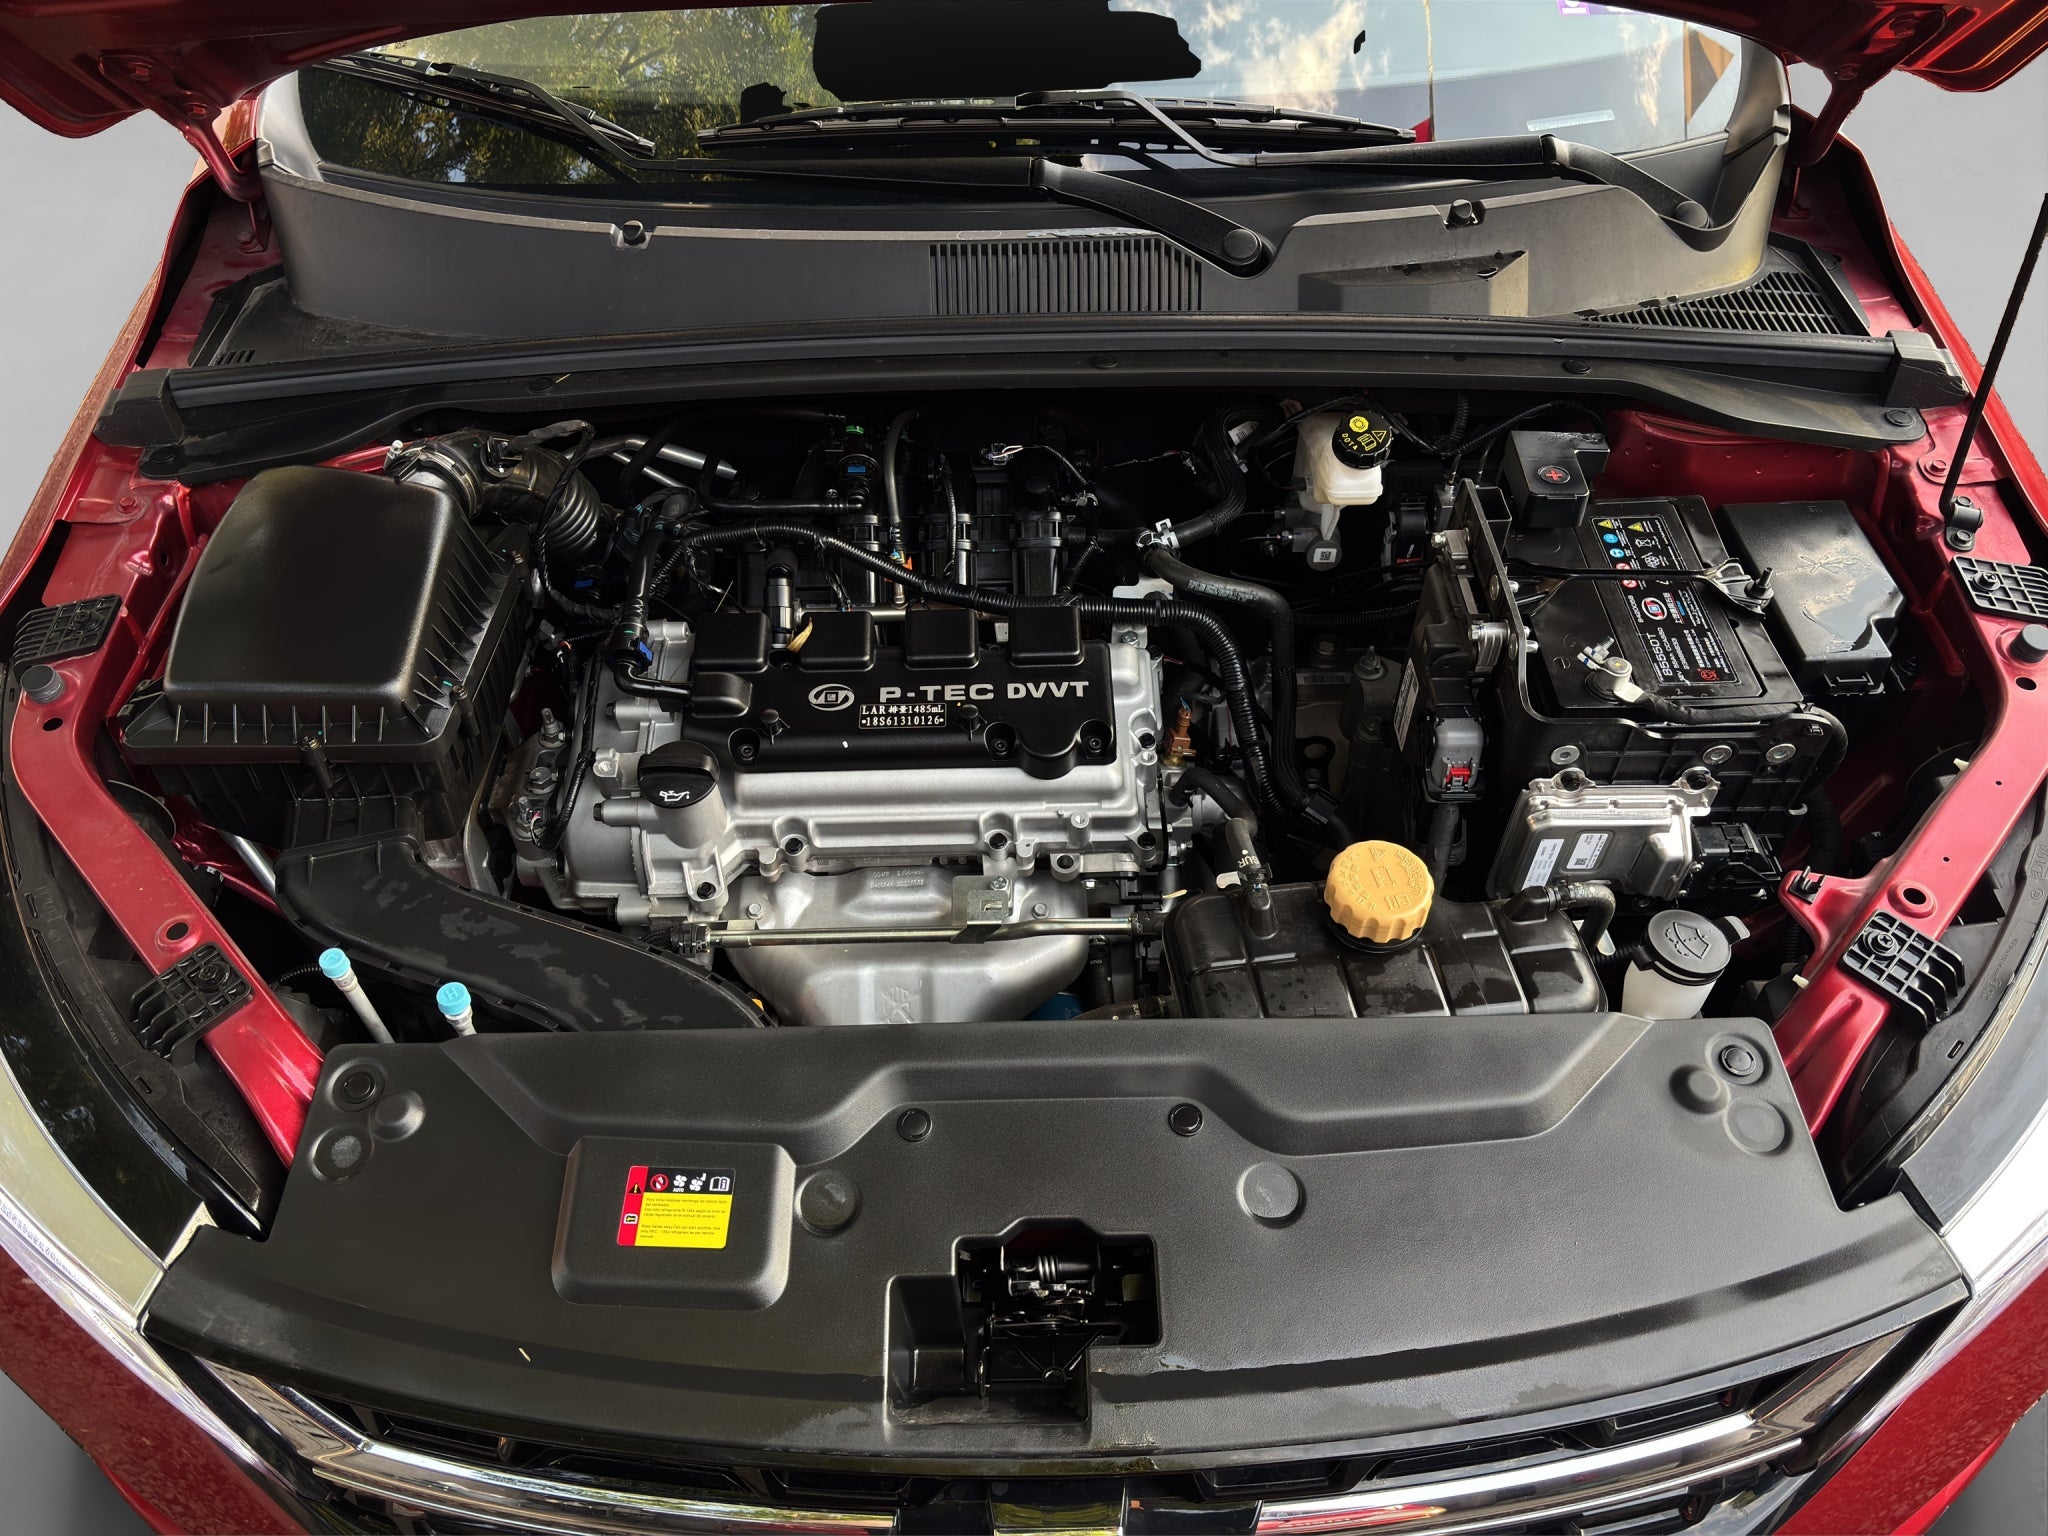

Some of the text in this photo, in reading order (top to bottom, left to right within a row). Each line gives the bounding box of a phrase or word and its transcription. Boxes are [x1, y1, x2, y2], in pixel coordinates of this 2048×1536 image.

[1646, 633, 1673, 676] 85550T
[880, 681, 1089, 703] P-TEC DVVT
[862, 705, 886, 715] LAR
[1237, 855, 1260, 868] SUR
